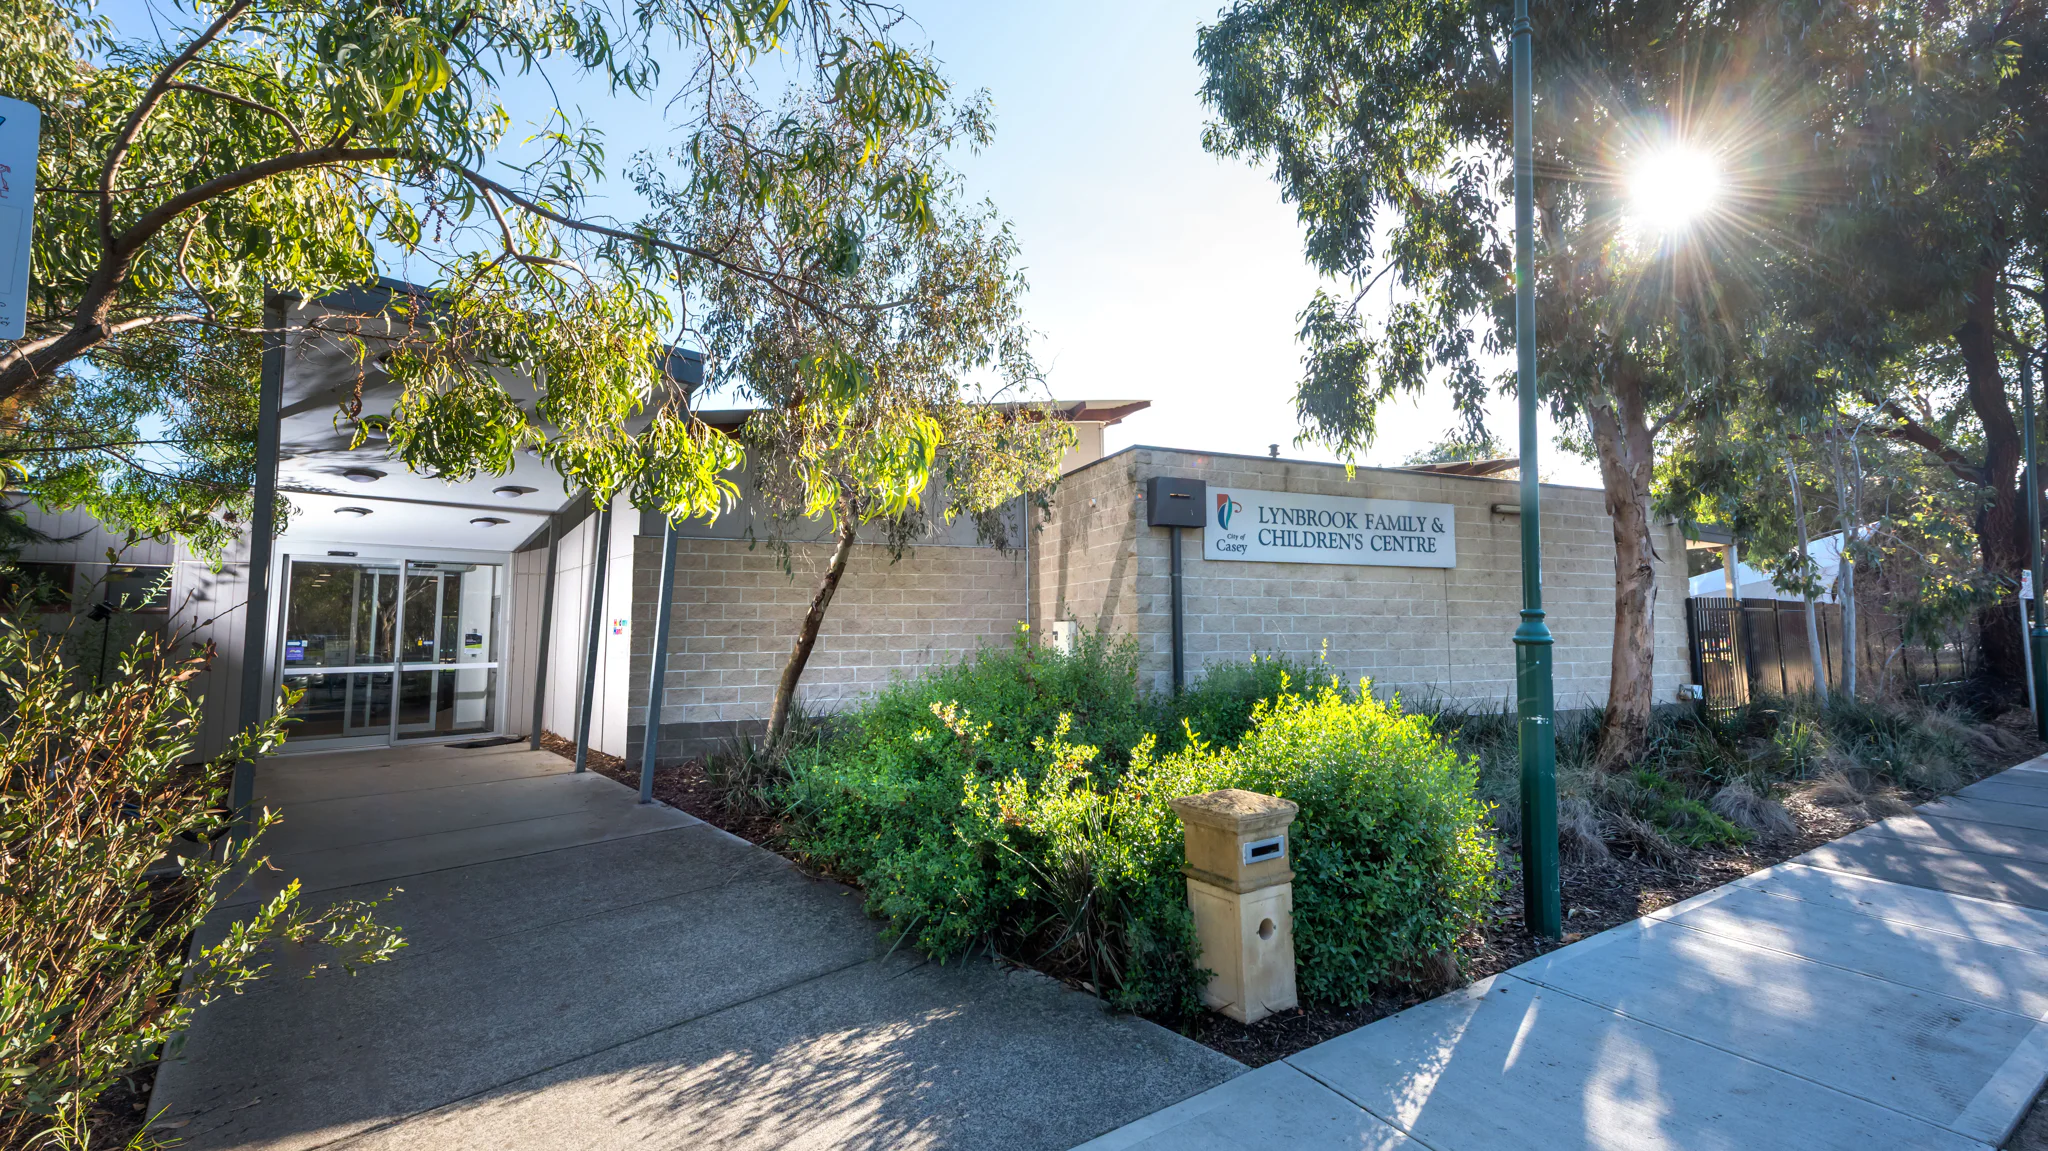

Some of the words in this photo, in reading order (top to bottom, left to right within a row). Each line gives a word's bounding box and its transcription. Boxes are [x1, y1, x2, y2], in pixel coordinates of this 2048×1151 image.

[1258, 506, 1358, 529] LYNBROOK
[1365, 513, 1427, 533] FAMILY
[1431, 516, 1446, 533] &
[1216, 538, 1248, 556] Casey
[1226, 533, 1239, 541] City
[1239, 533, 1246, 541] of
[1258, 528, 1363, 550] CHILDREN'S
[1370, 534, 1437, 553] CENTRE
